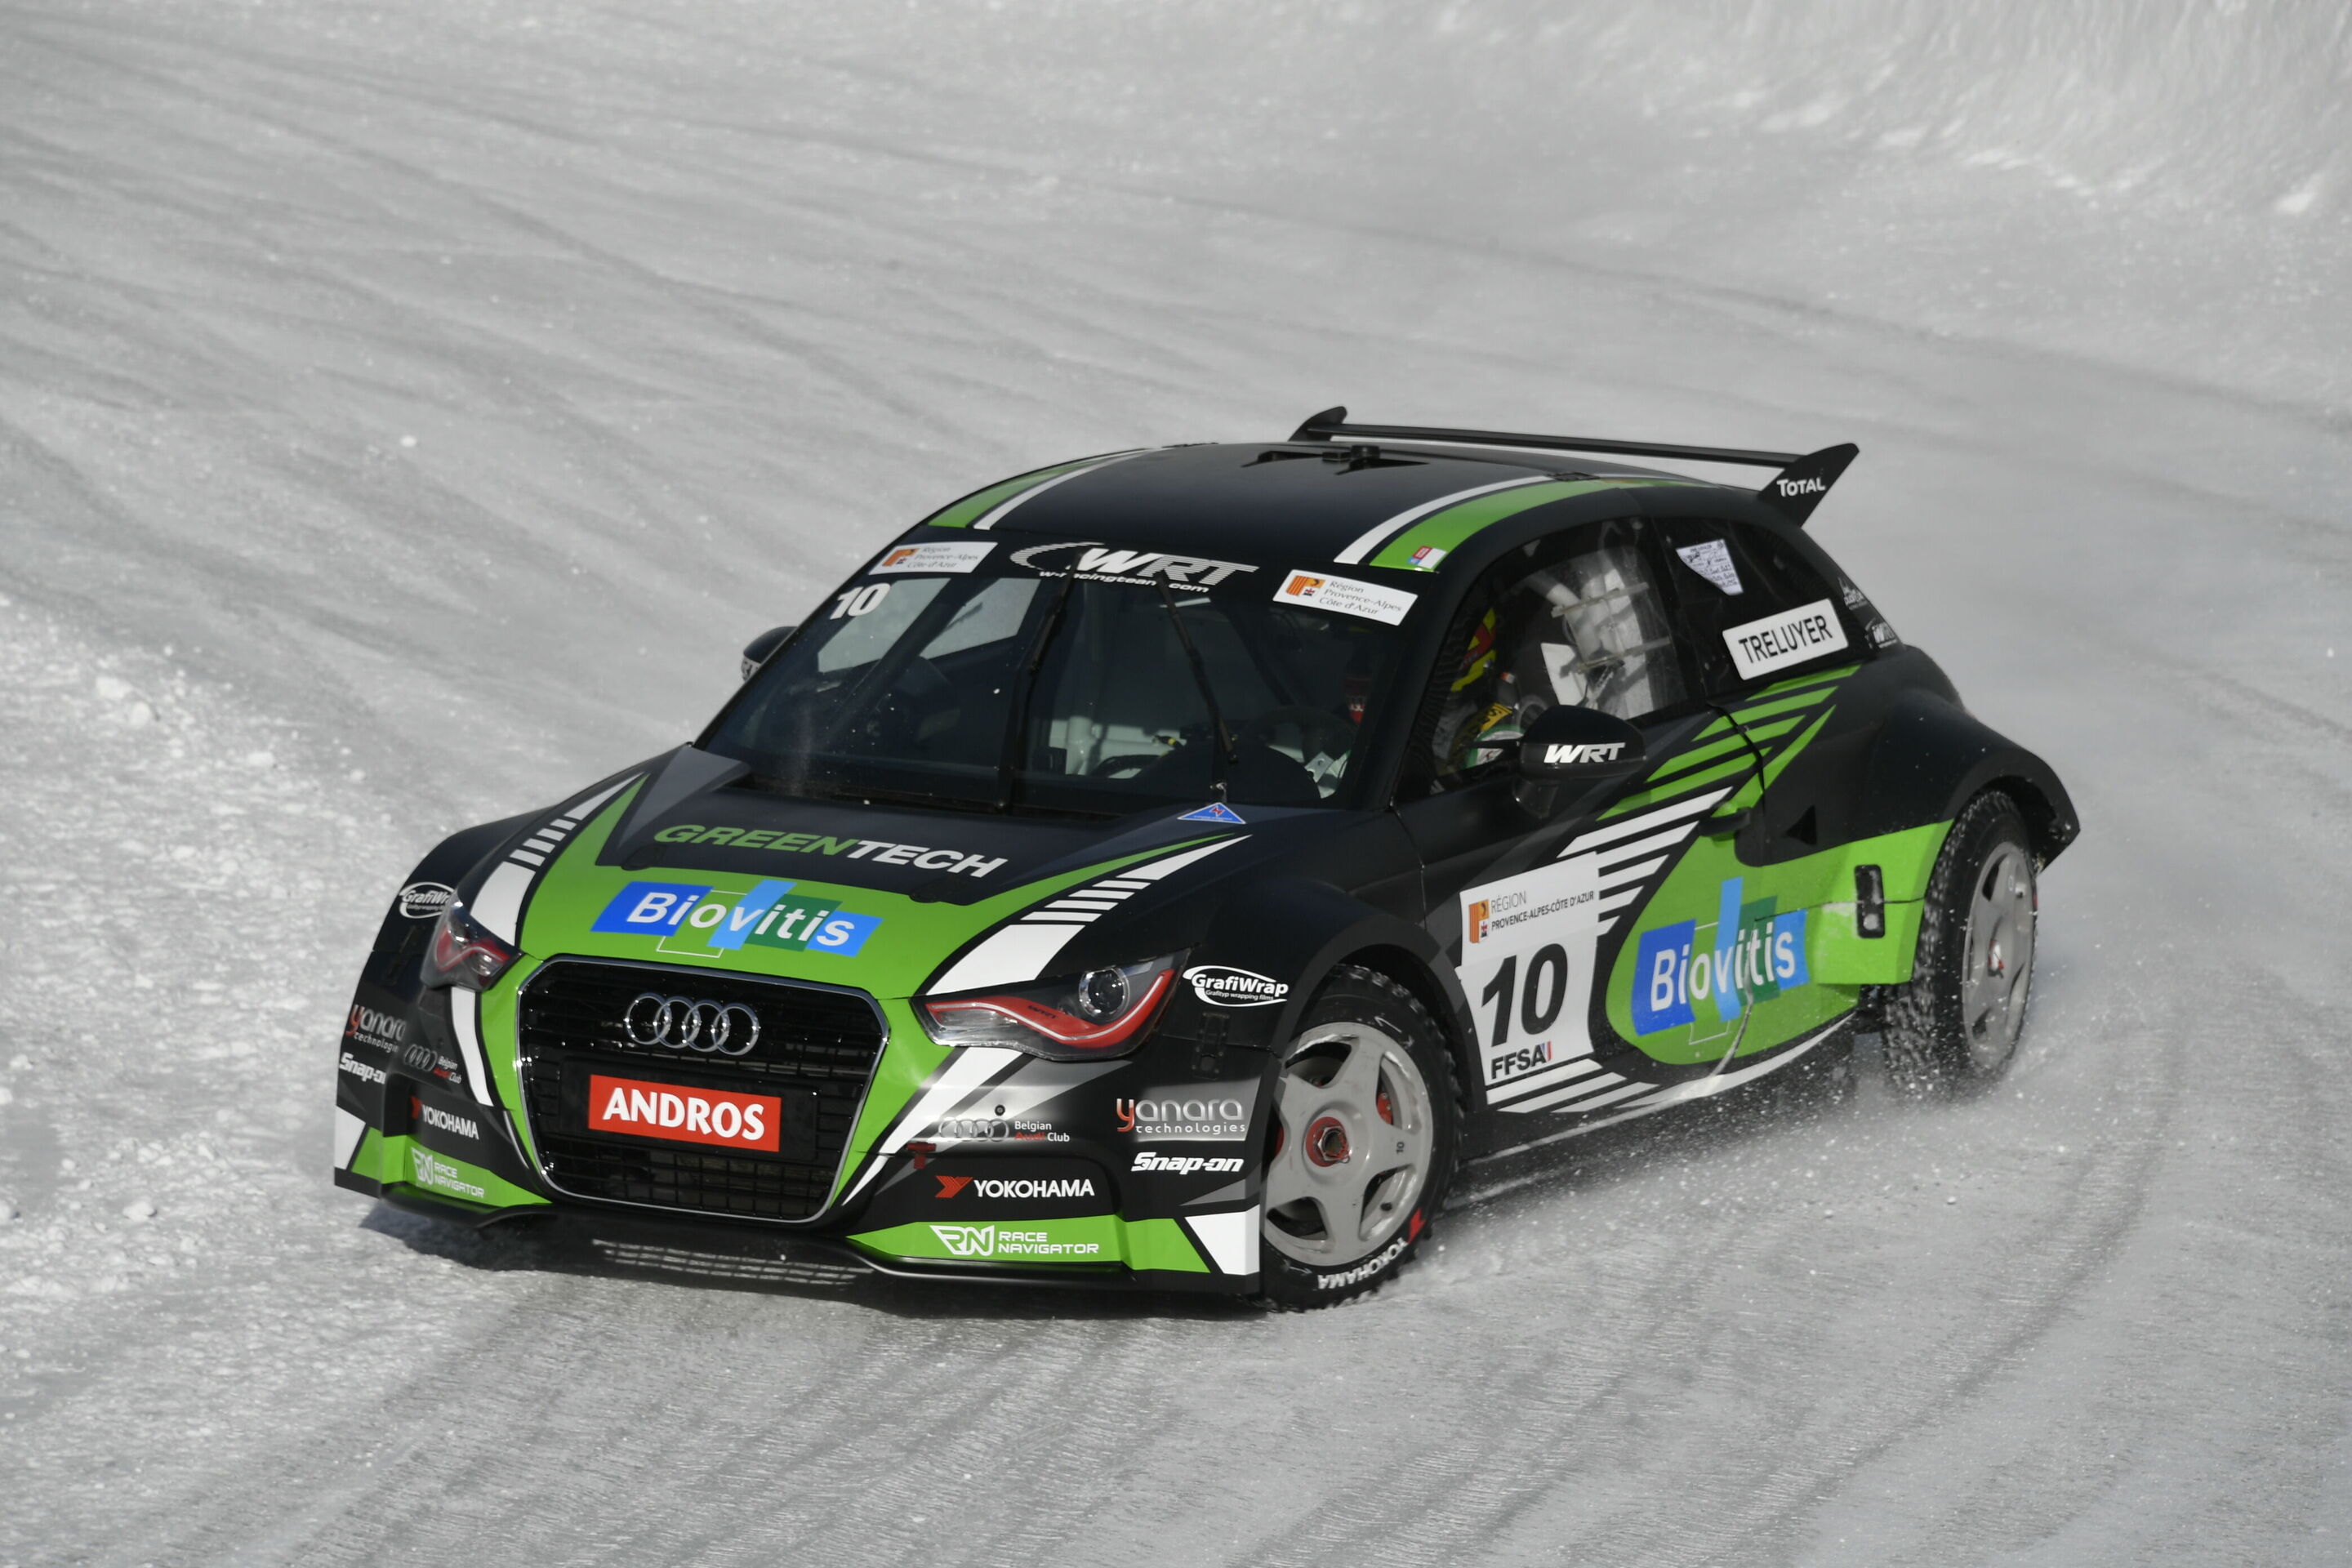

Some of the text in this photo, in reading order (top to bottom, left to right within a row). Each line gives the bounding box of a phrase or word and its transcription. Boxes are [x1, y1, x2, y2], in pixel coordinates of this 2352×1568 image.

[1776, 477, 1826, 497] TOTAL
[1065, 548, 1259, 586] WRT
[1330, 581, 1364, 593] Région
[830, 583, 891, 620] 10
[1319, 597, 1342, 606] Côte
[1324, 589, 1402, 611] Provence-Alpes
[1738, 615, 1833, 664] TRELUYER
[1544, 742, 1625, 763] WRT
[653, 824, 1008, 878] GREENTECH
[1490, 891, 1526, 914] RÉGION
[1491, 890, 1594, 931] PROVENCE-ALPES-CÔTE D'AZUR
[626, 892, 855, 947] Biovitis
[1650, 921, 1796, 1012] Biovitis
[1192, 973, 1289, 997] GrafiWrap
[1205, 990, 1229, 998] Grafityp
[1481, 943, 1568, 1048] 10
[339, 1052, 386, 1085] Snap-o
[1490, 1043, 1547, 1080] FFSA
[421, 1103, 479, 1140] YOKOHAMA
[603, 1087, 765, 1140] ANDROS
[1116, 1098, 1244, 1132] yanara
[1014, 1120, 1052, 1132] Belgian
[1047, 1132, 1071, 1142] Club
[1135, 1122, 1245, 1134] technologies
[1396, 1142, 1405, 1155] 10
[434, 1161, 457, 1178] RACE
[1130, 1152, 1244, 1174] Snap-on
[434, 1174, 484, 1198] NAVIGATOR
[973, 1178, 1095, 1198] YOKOHAMA
[999, 1232, 1047, 1242] RACE
[999, 1244, 1098, 1254] NAVIGATOR
[1316, 1236, 1408, 1290] YOKOHAMA
